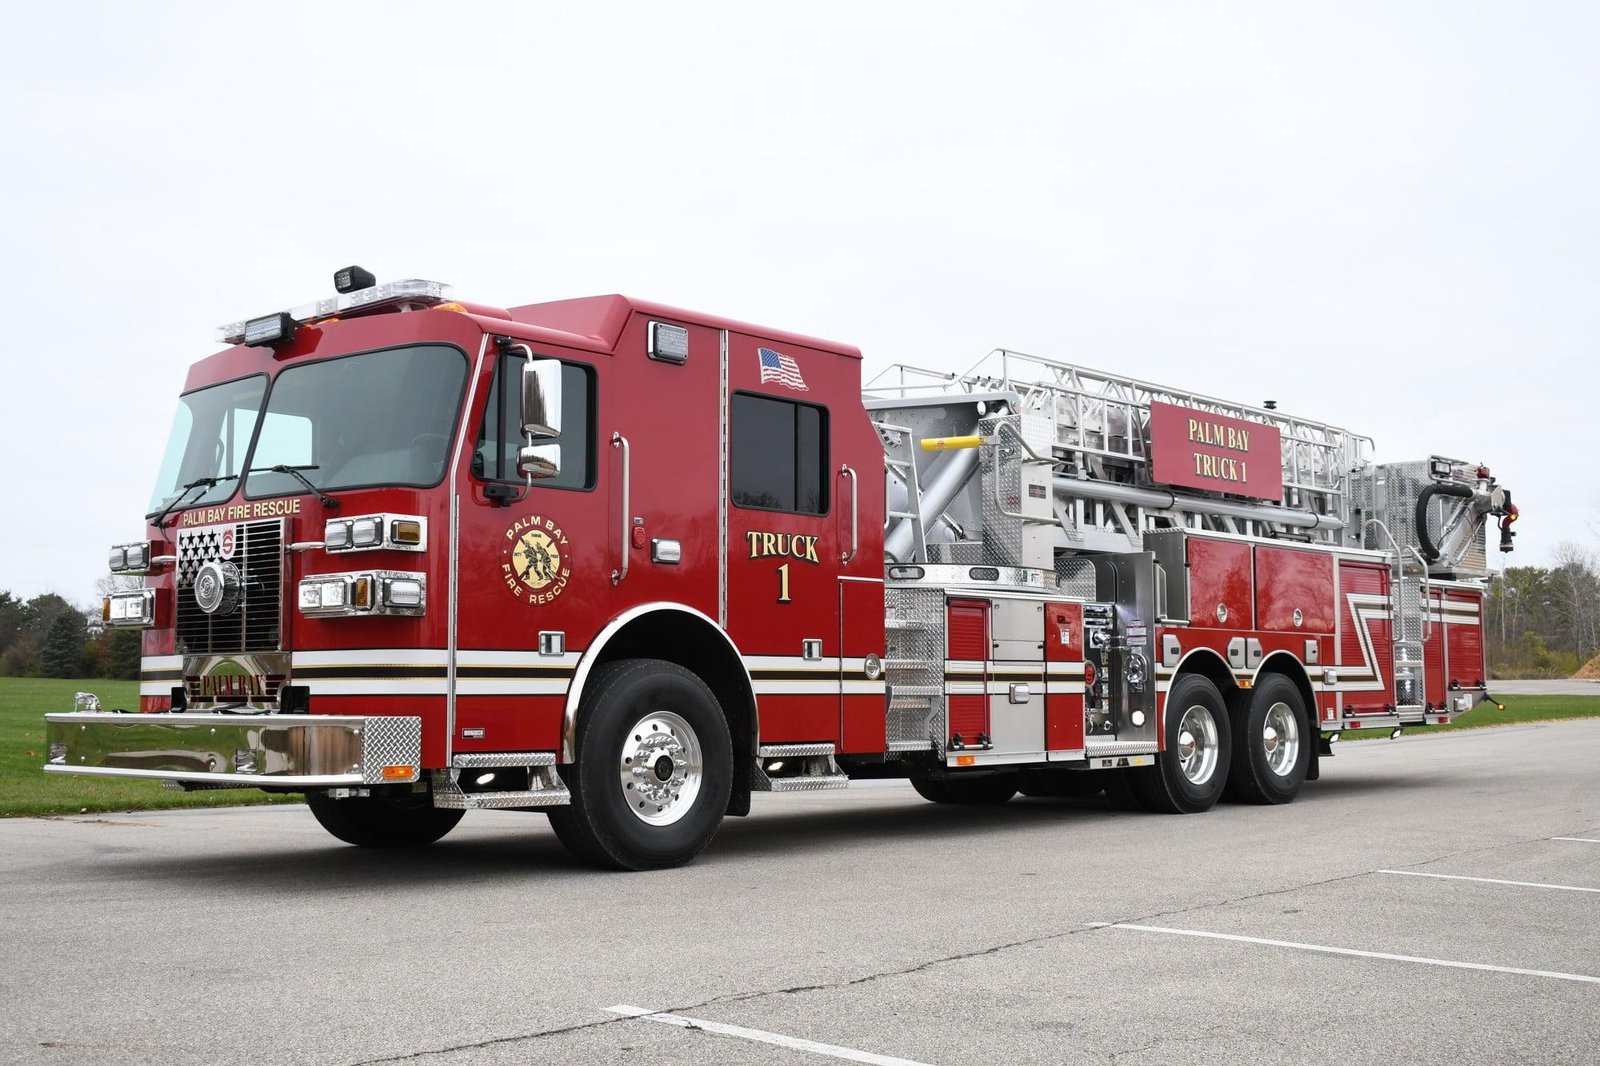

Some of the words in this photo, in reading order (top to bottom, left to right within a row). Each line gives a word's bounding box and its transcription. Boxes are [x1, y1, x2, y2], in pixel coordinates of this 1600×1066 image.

[1188, 418, 1224, 447] PALM
[1227, 427, 1249, 452] BAY
[1193, 452, 1238, 481] TRUCK
[1241, 461, 1248, 483] 1
[183, 511, 206, 526] PALM
[207, 507, 226, 523] BAY
[228, 504, 251, 520] FIRE
[253, 499, 301, 517] RESCUE
[506, 515, 541, 540] PALM
[545, 519, 569, 545] BAY
[746, 530, 820, 564] TRUCK
[501, 563, 523, 597] FIRE
[529, 567, 571, 605] RESCUE
[777, 563, 792, 602] 1
[202, 675, 233, 696] PALM
[238, 674, 263, 696] BAY
